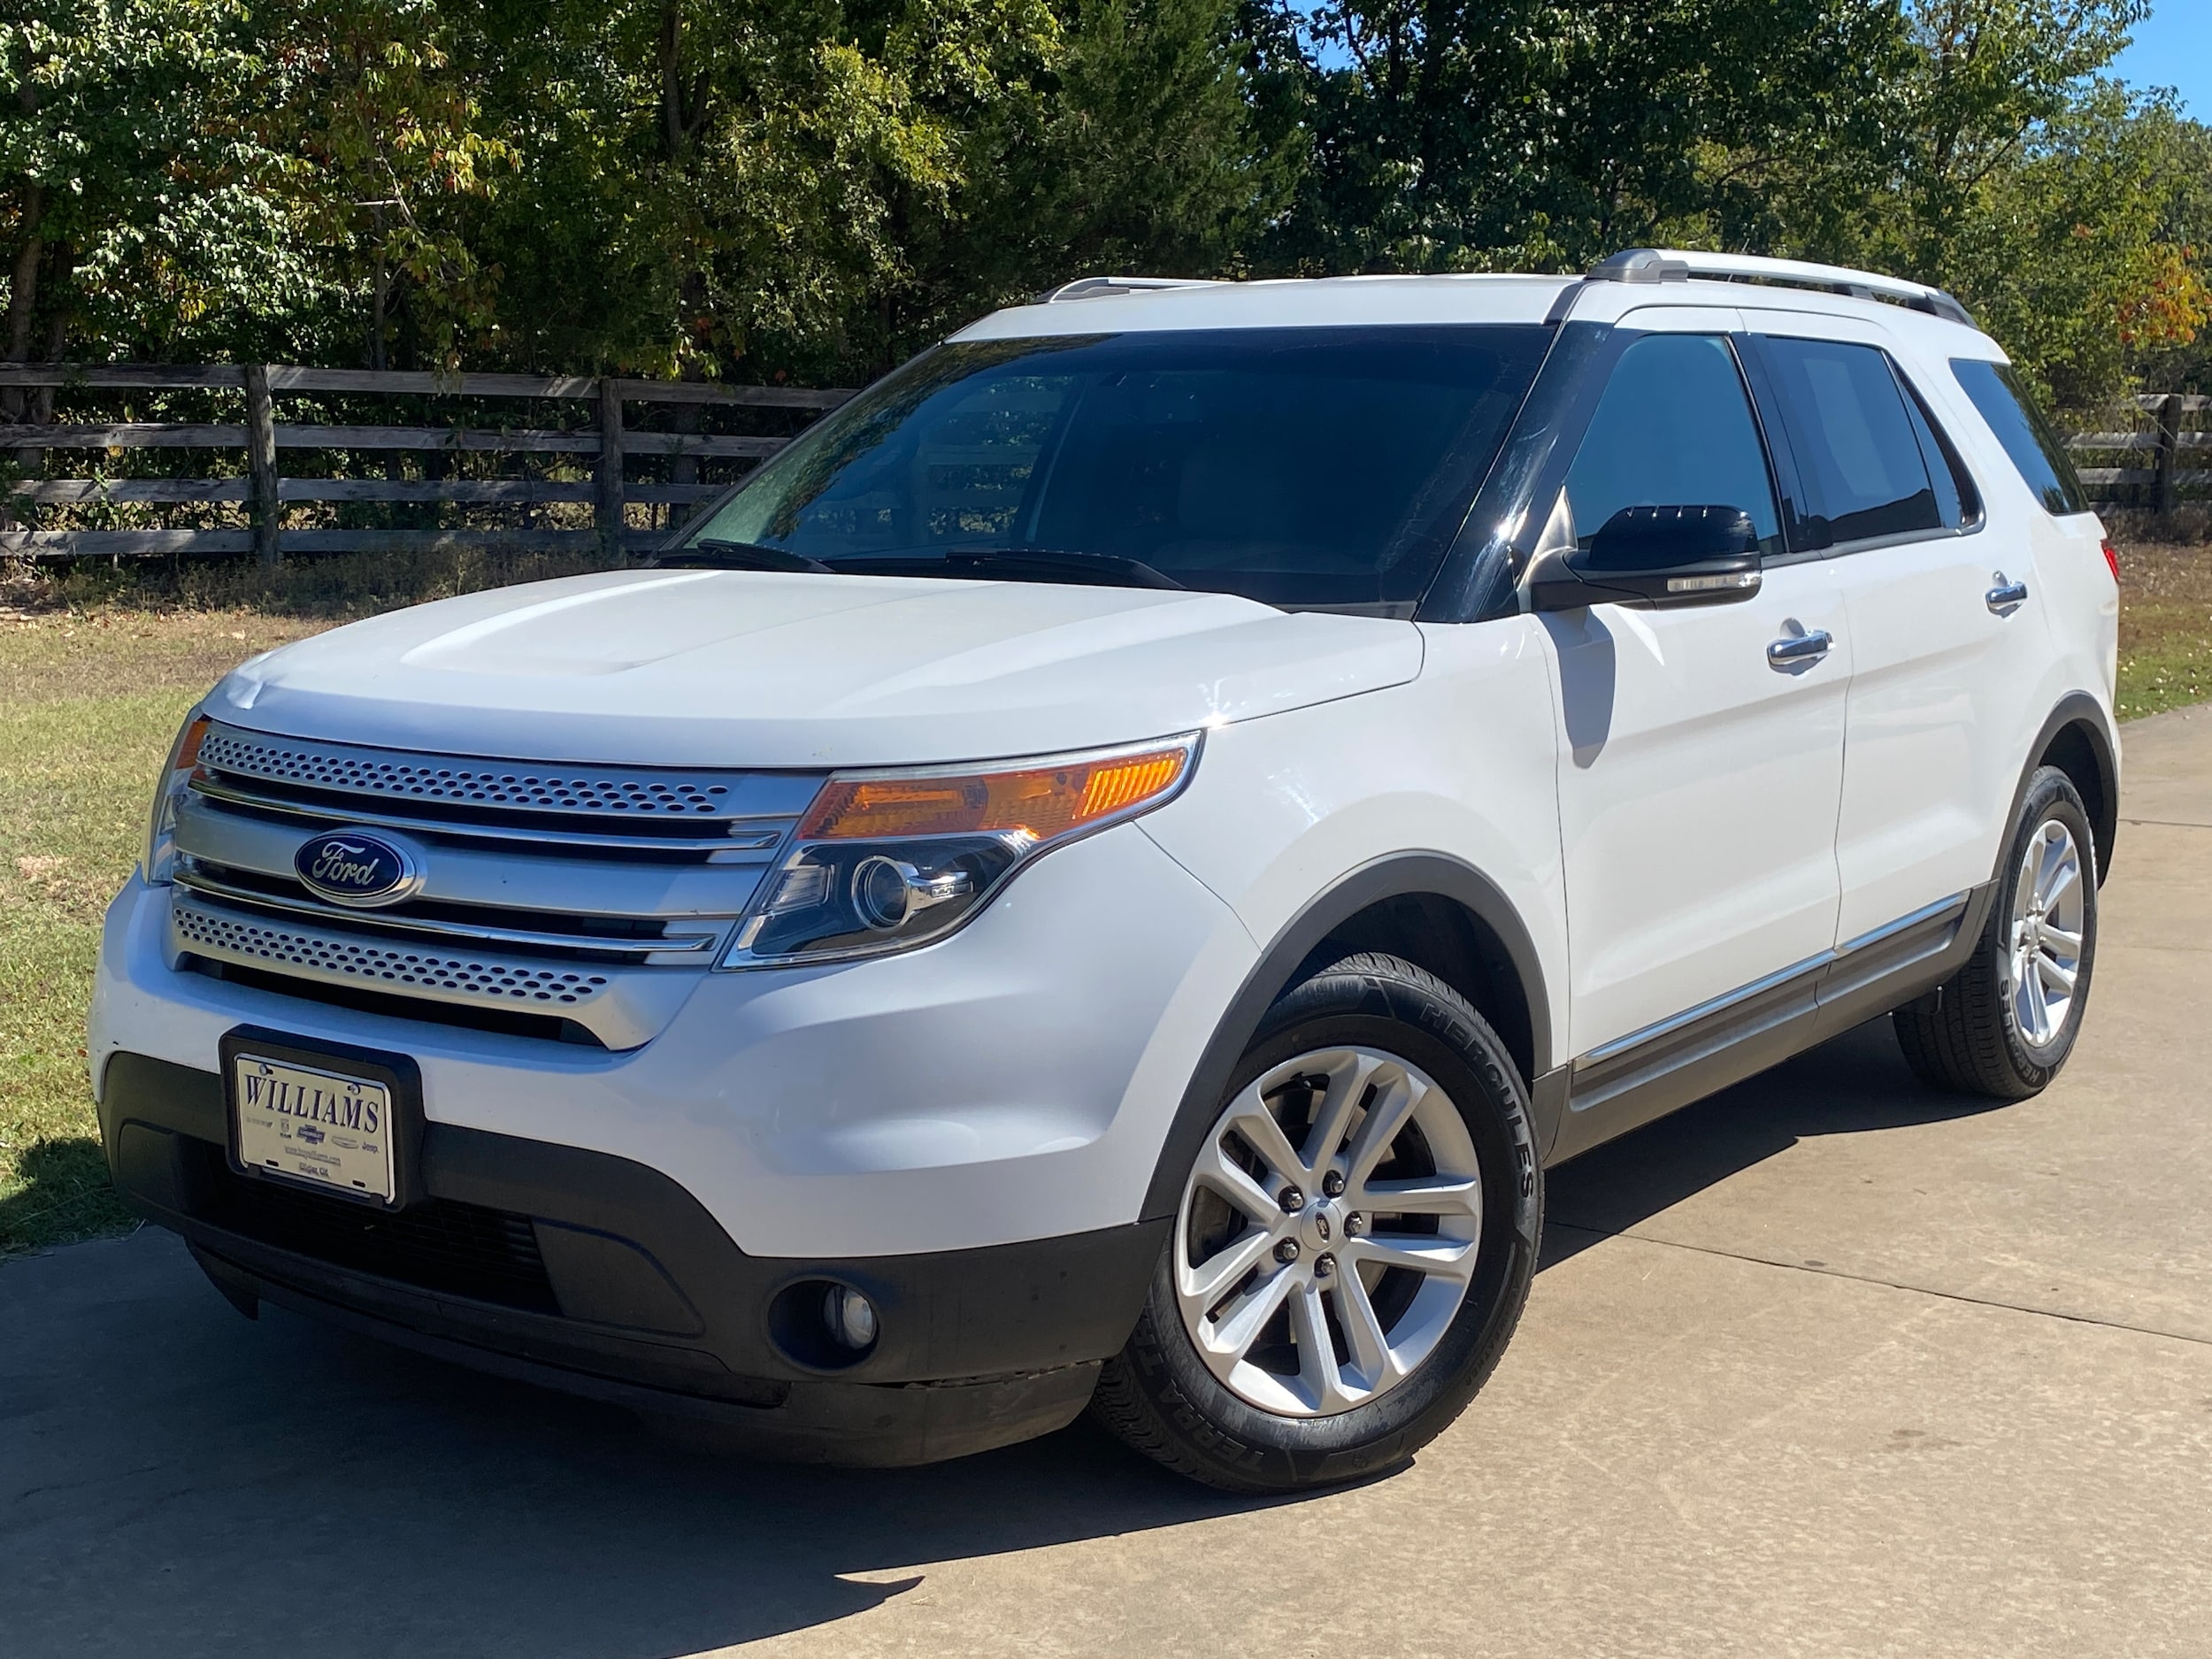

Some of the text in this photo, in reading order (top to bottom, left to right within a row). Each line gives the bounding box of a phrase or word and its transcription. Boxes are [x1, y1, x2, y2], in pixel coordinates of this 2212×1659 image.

[311, 841, 380, 886] Ford
[244, 1073, 380, 1133] WILLIAMS
[1418, 1002, 1534, 1199] HERCULES
